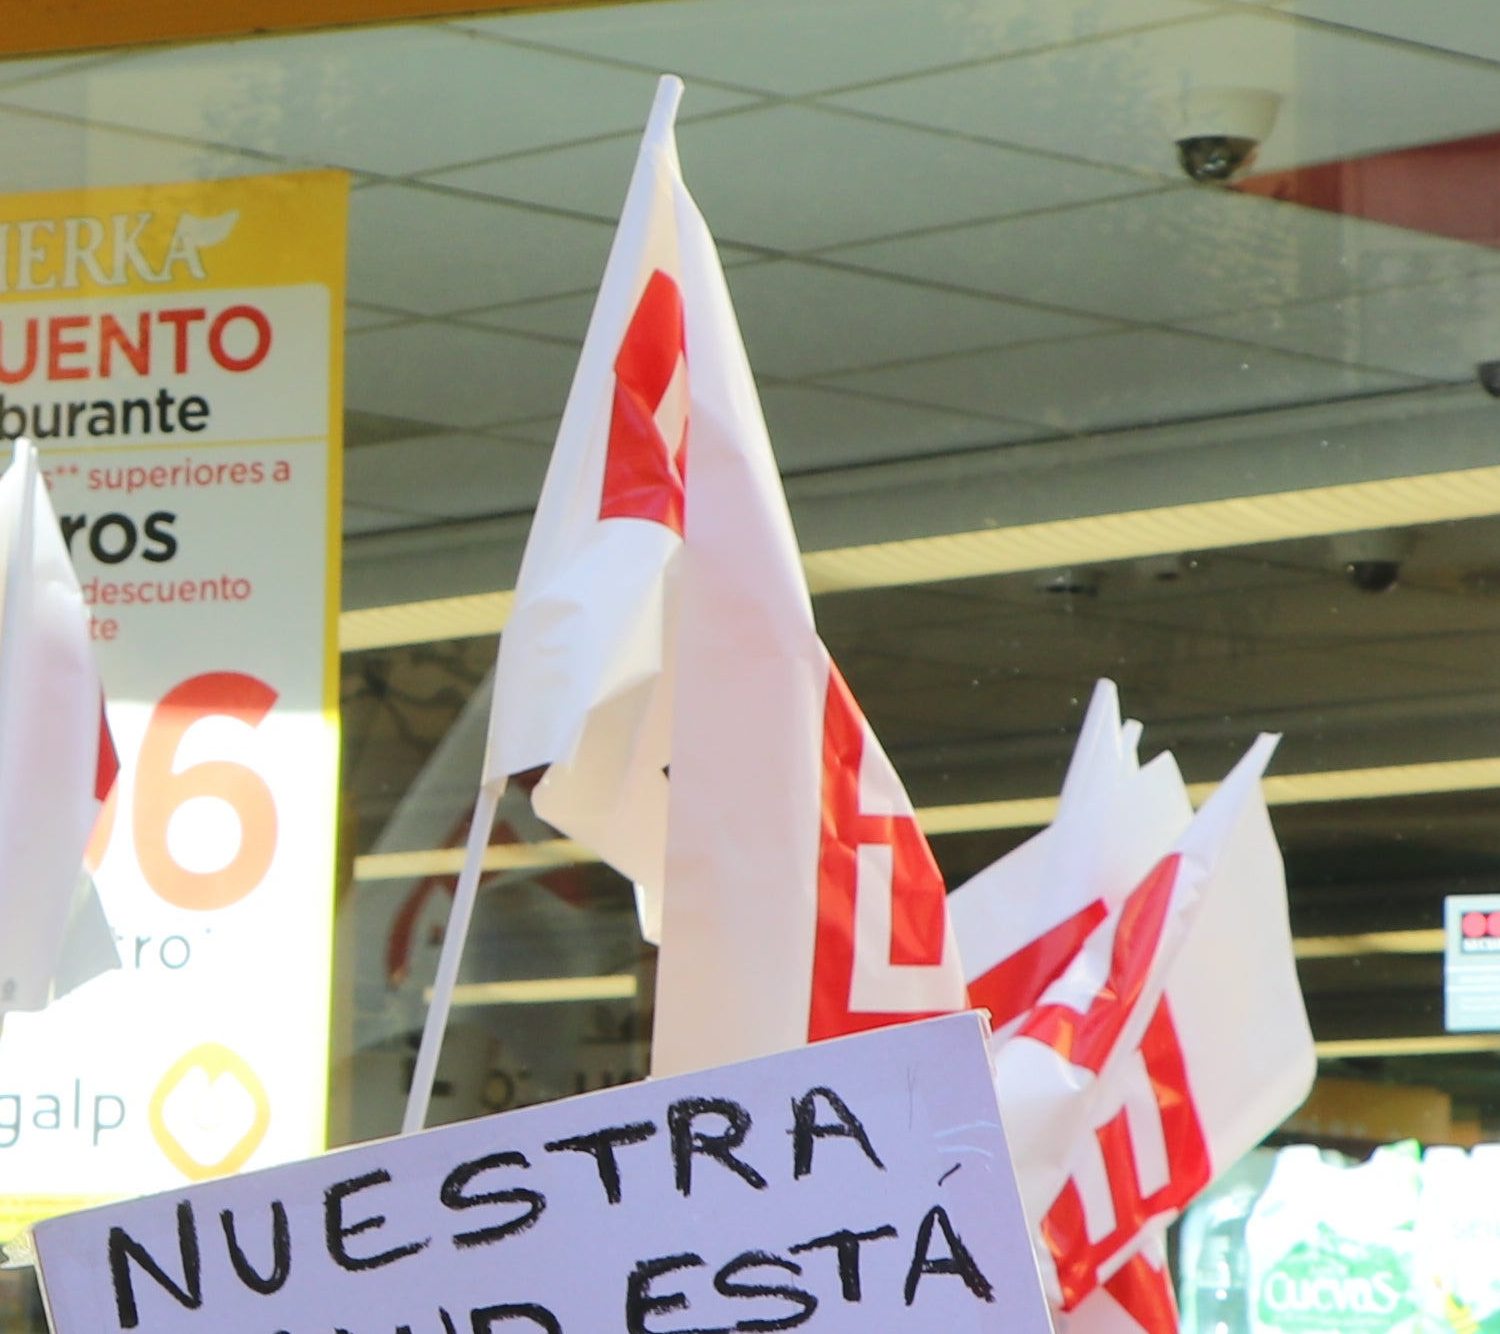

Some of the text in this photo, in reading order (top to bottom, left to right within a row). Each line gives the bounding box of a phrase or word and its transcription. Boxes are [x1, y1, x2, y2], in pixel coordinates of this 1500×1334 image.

[86, 458, 265, 497] superiores
[272, 460, 292, 483] a
[82, 571, 253, 605] descuento
[107, 1084, 886, 1329] NUESTRA
